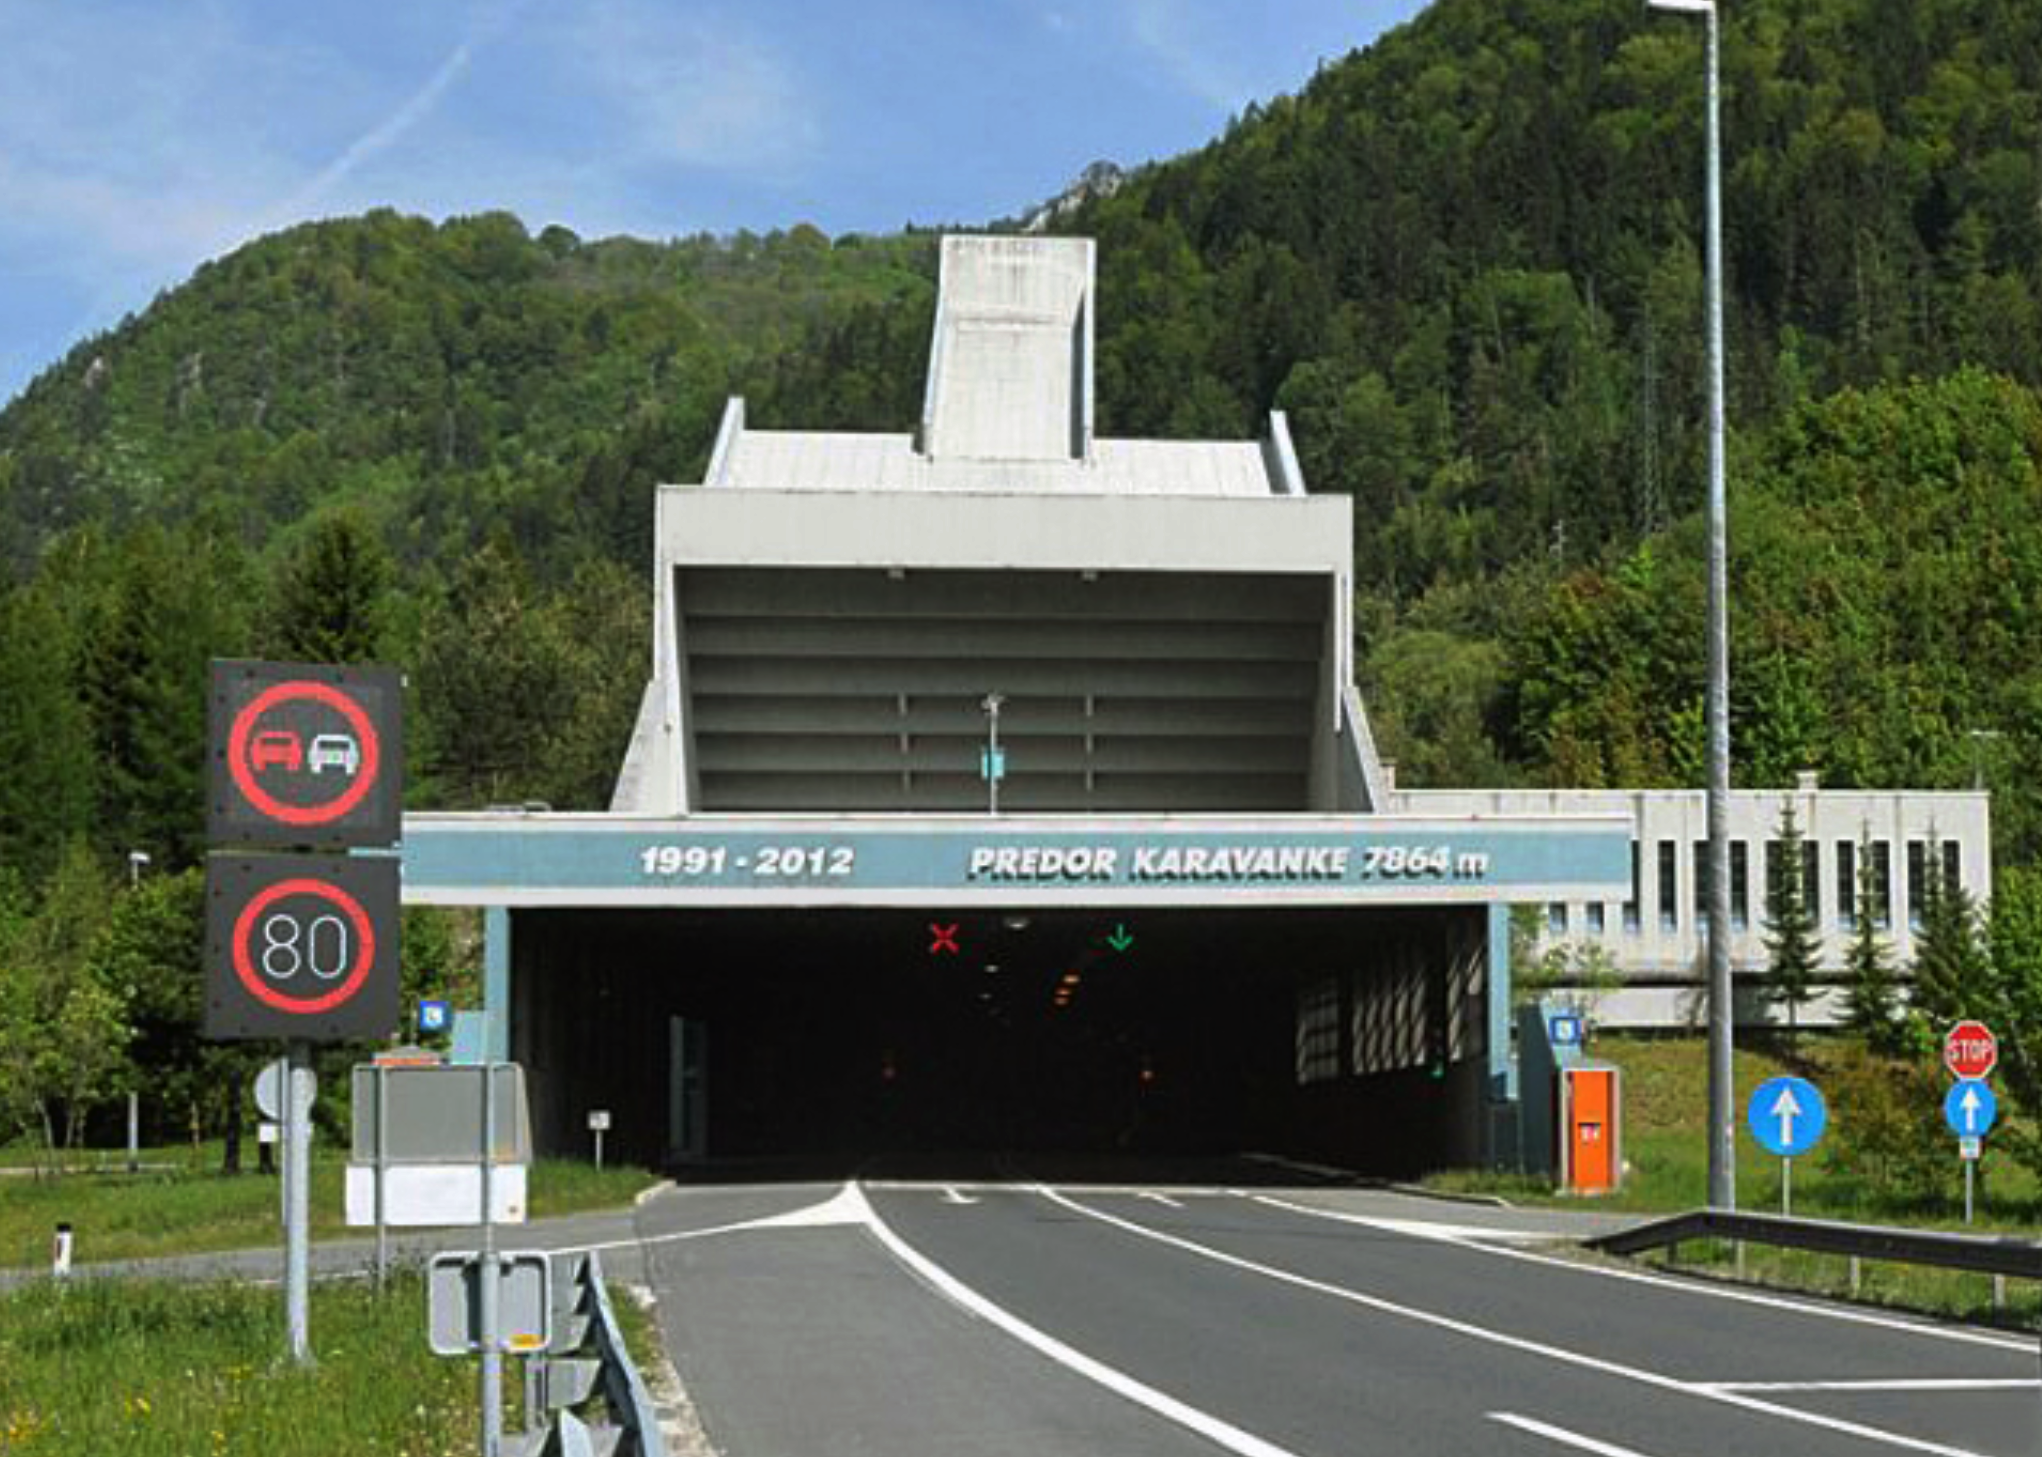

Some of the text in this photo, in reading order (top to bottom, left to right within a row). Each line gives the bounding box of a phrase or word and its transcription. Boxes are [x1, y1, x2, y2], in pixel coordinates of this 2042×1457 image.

[640, 845, 727, 875] 1991
[753, 846, 856, 876] 2012
[967, 846, 1489, 880] PREDOR KARAVANKE 7864 m
[262, 913, 347, 979] 80
[1947, 1038, 1993, 1062] STOP
